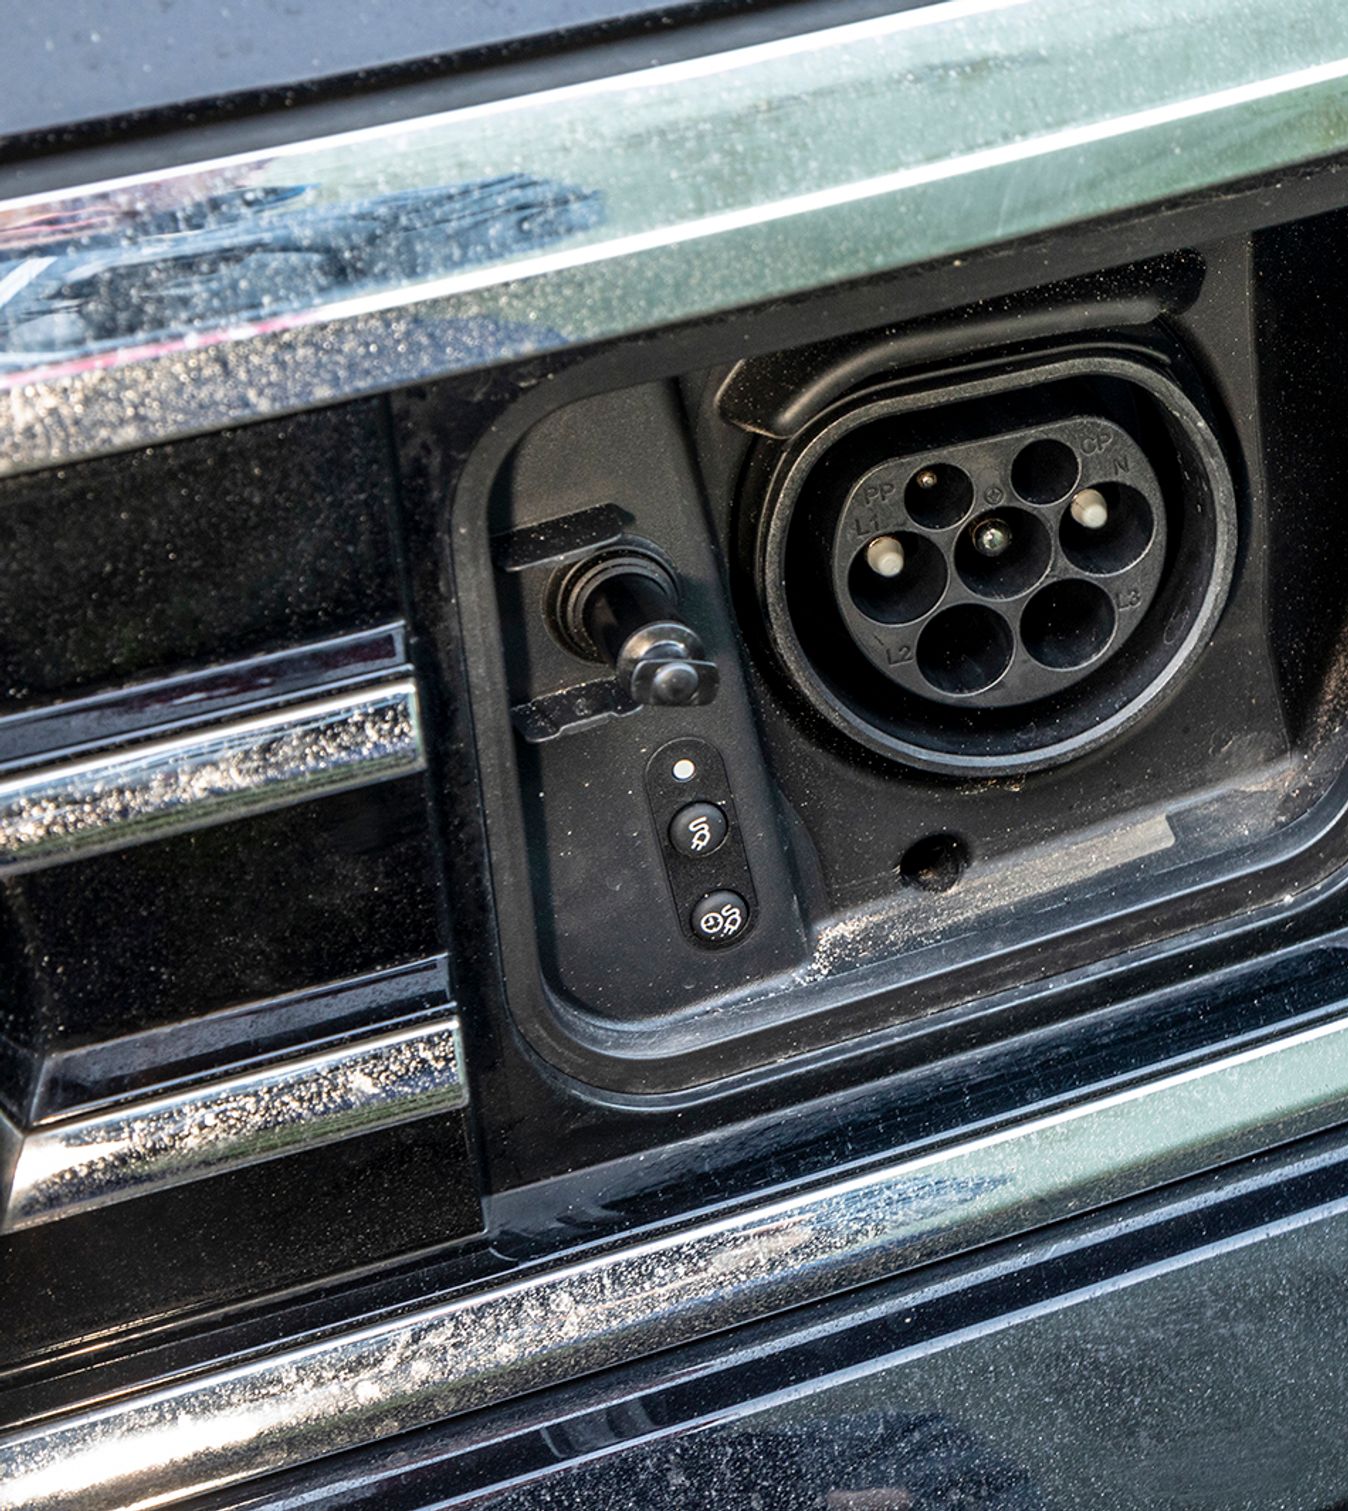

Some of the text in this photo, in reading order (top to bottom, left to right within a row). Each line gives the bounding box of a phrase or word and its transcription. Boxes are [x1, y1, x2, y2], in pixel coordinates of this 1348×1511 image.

[1080, 431, 1114, 457] CP
[1112, 455, 1130, 476] N
[862, 482, 896, 507] PP
[854, 513, 880, 536] L1
[1115, 588, 1142, 611] L3
[885, 645, 914, 667] L2
